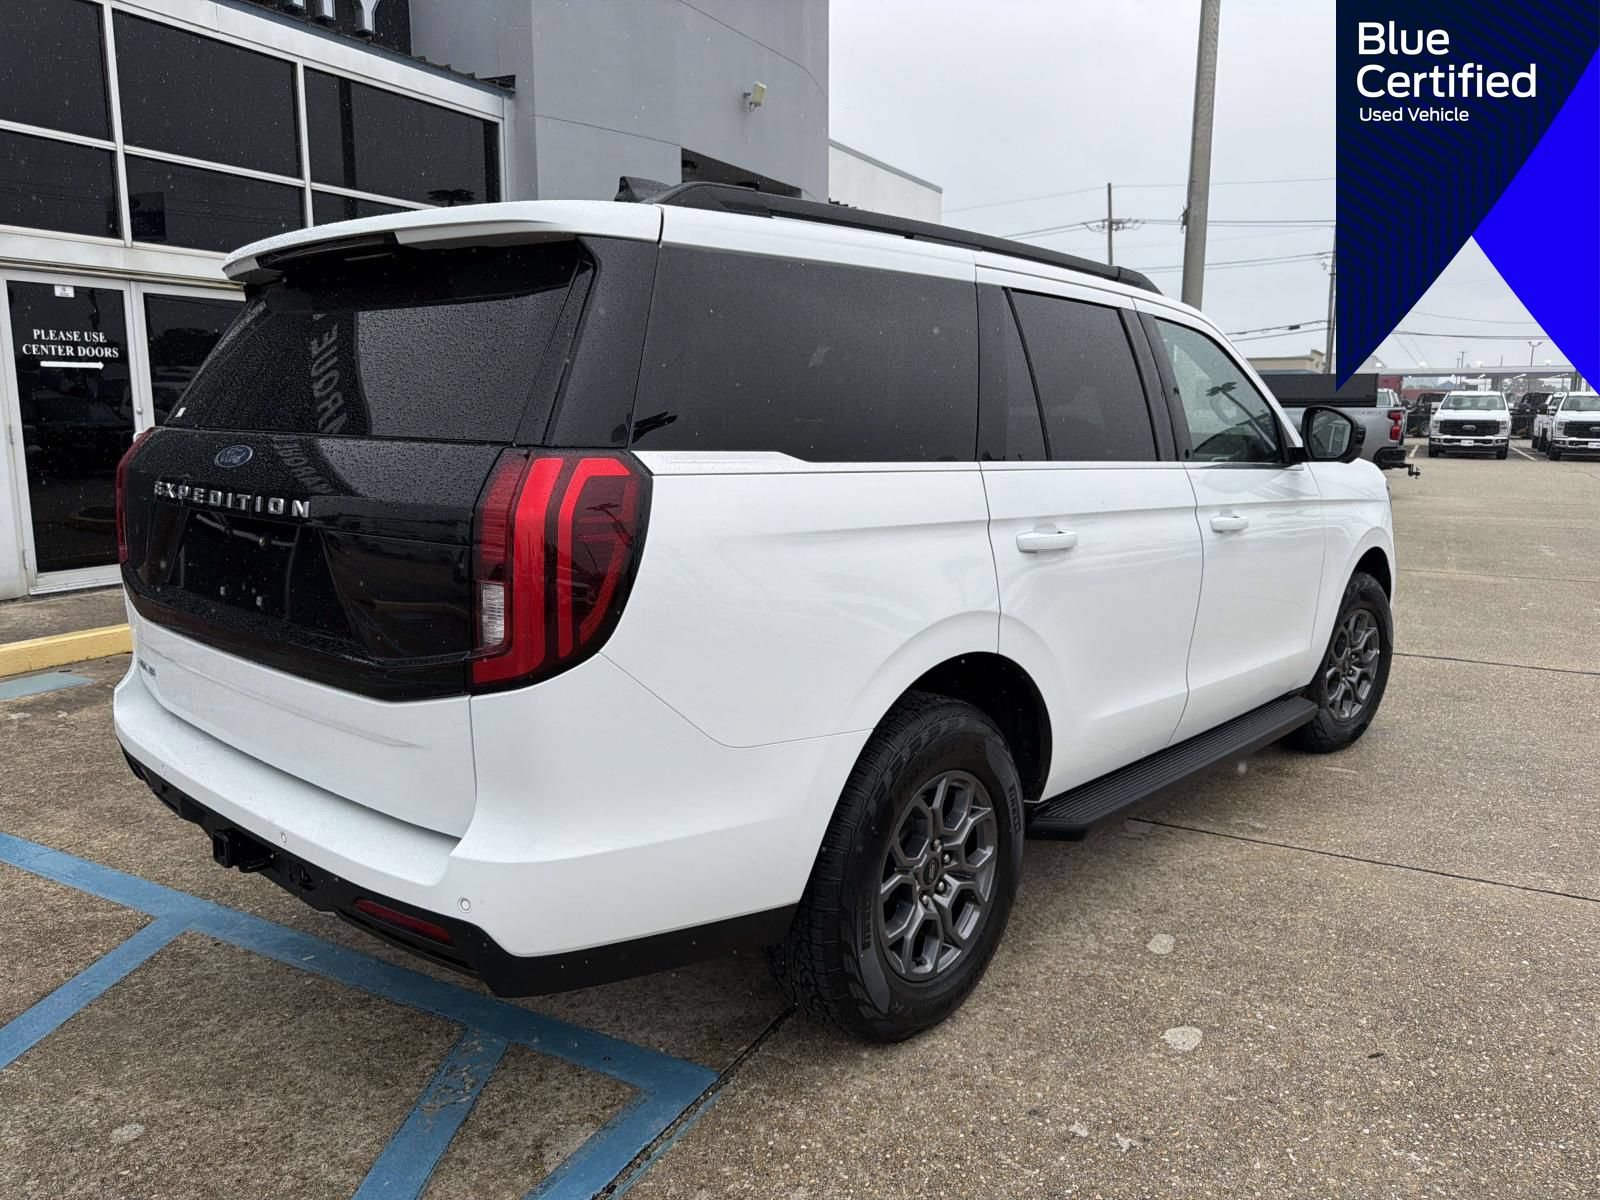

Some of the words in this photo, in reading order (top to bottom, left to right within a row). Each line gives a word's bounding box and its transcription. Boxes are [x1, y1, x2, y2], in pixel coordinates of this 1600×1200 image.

[32, 328, 81, 342] PLEASE
[84, 331, 107, 343] USE
[22, 343, 75, 357] CENTER
[77, 346, 119, 358] DOORS
[154, 480, 310, 518] EXPEDITION
